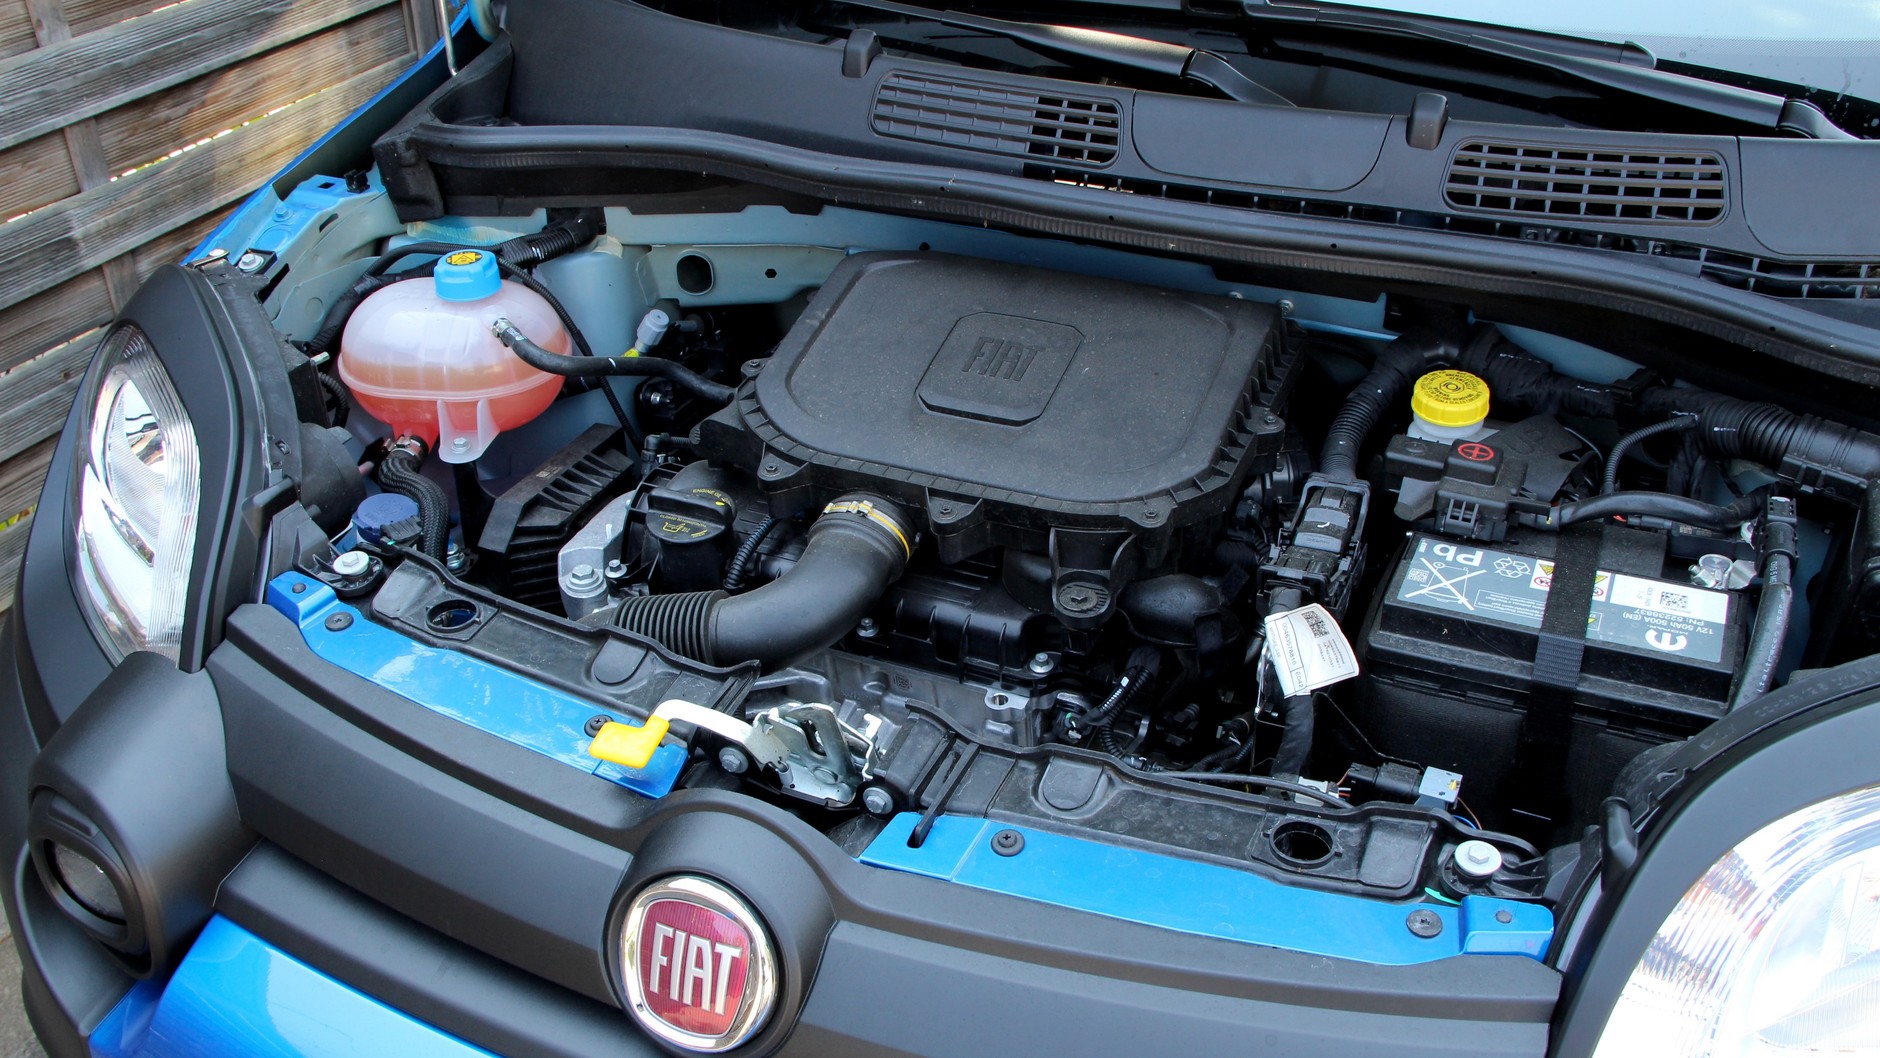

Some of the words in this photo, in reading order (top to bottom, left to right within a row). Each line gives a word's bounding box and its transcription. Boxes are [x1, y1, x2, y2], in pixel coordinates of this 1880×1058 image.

[961, 336, 1046, 382] FIAT
[1432, 543, 1484, 567] Pb
[1622, 611, 1642, 621] (EN)
[1644, 616, 1667, 626] 500A
[1669, 621, 1694, 631] 50Ah
[1696, 626, 1714, 635] 12V
[1294, 671, 1304, 688] E042
[650, 922, 743, 1016] FIAT
